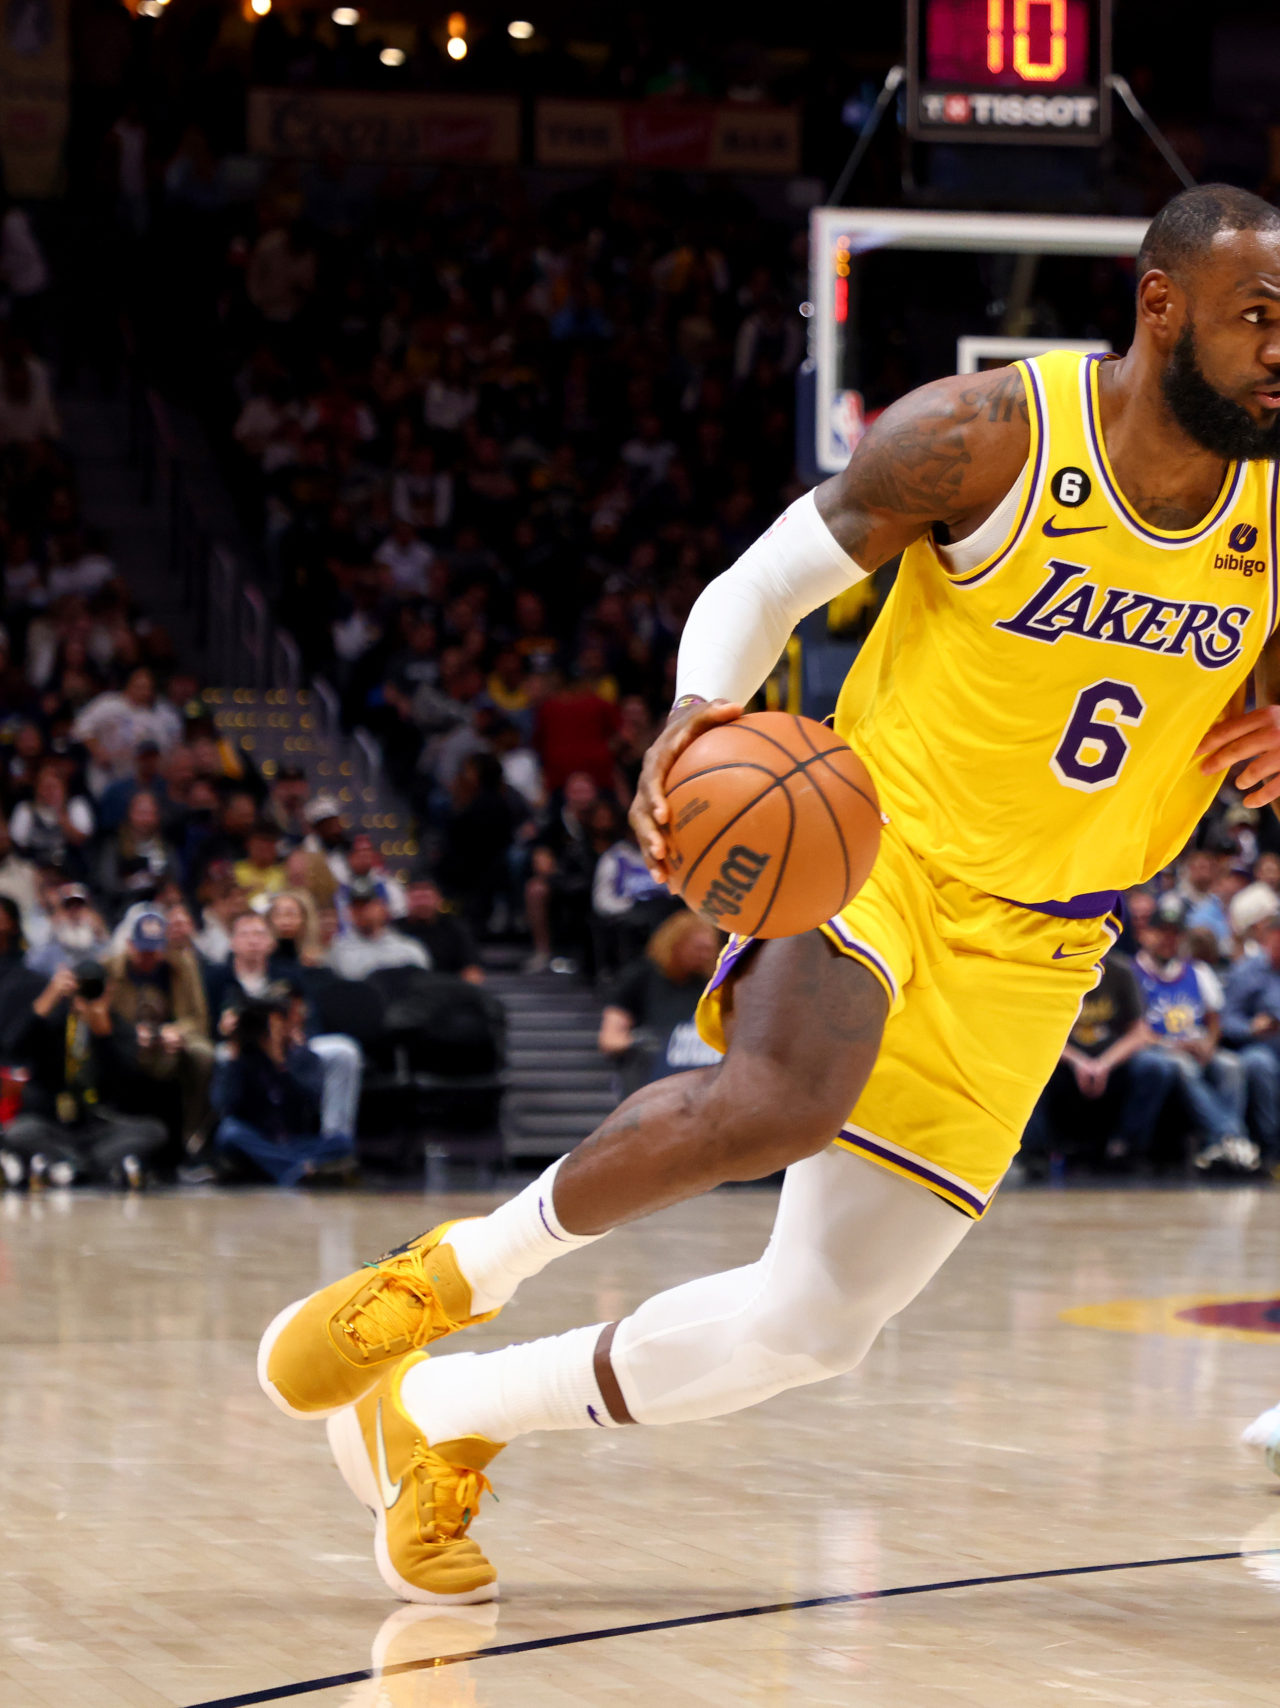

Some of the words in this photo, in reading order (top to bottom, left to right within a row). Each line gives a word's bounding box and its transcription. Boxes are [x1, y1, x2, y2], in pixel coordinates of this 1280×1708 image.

[987, 0, 1067, 81] 10
[1059, 471, 1083, 503] 6
[1213, 553, 1266, 578] bibigo
[992, 557, 1254, 671] LAKERS
[1048, 677, 1148, 794] 6
